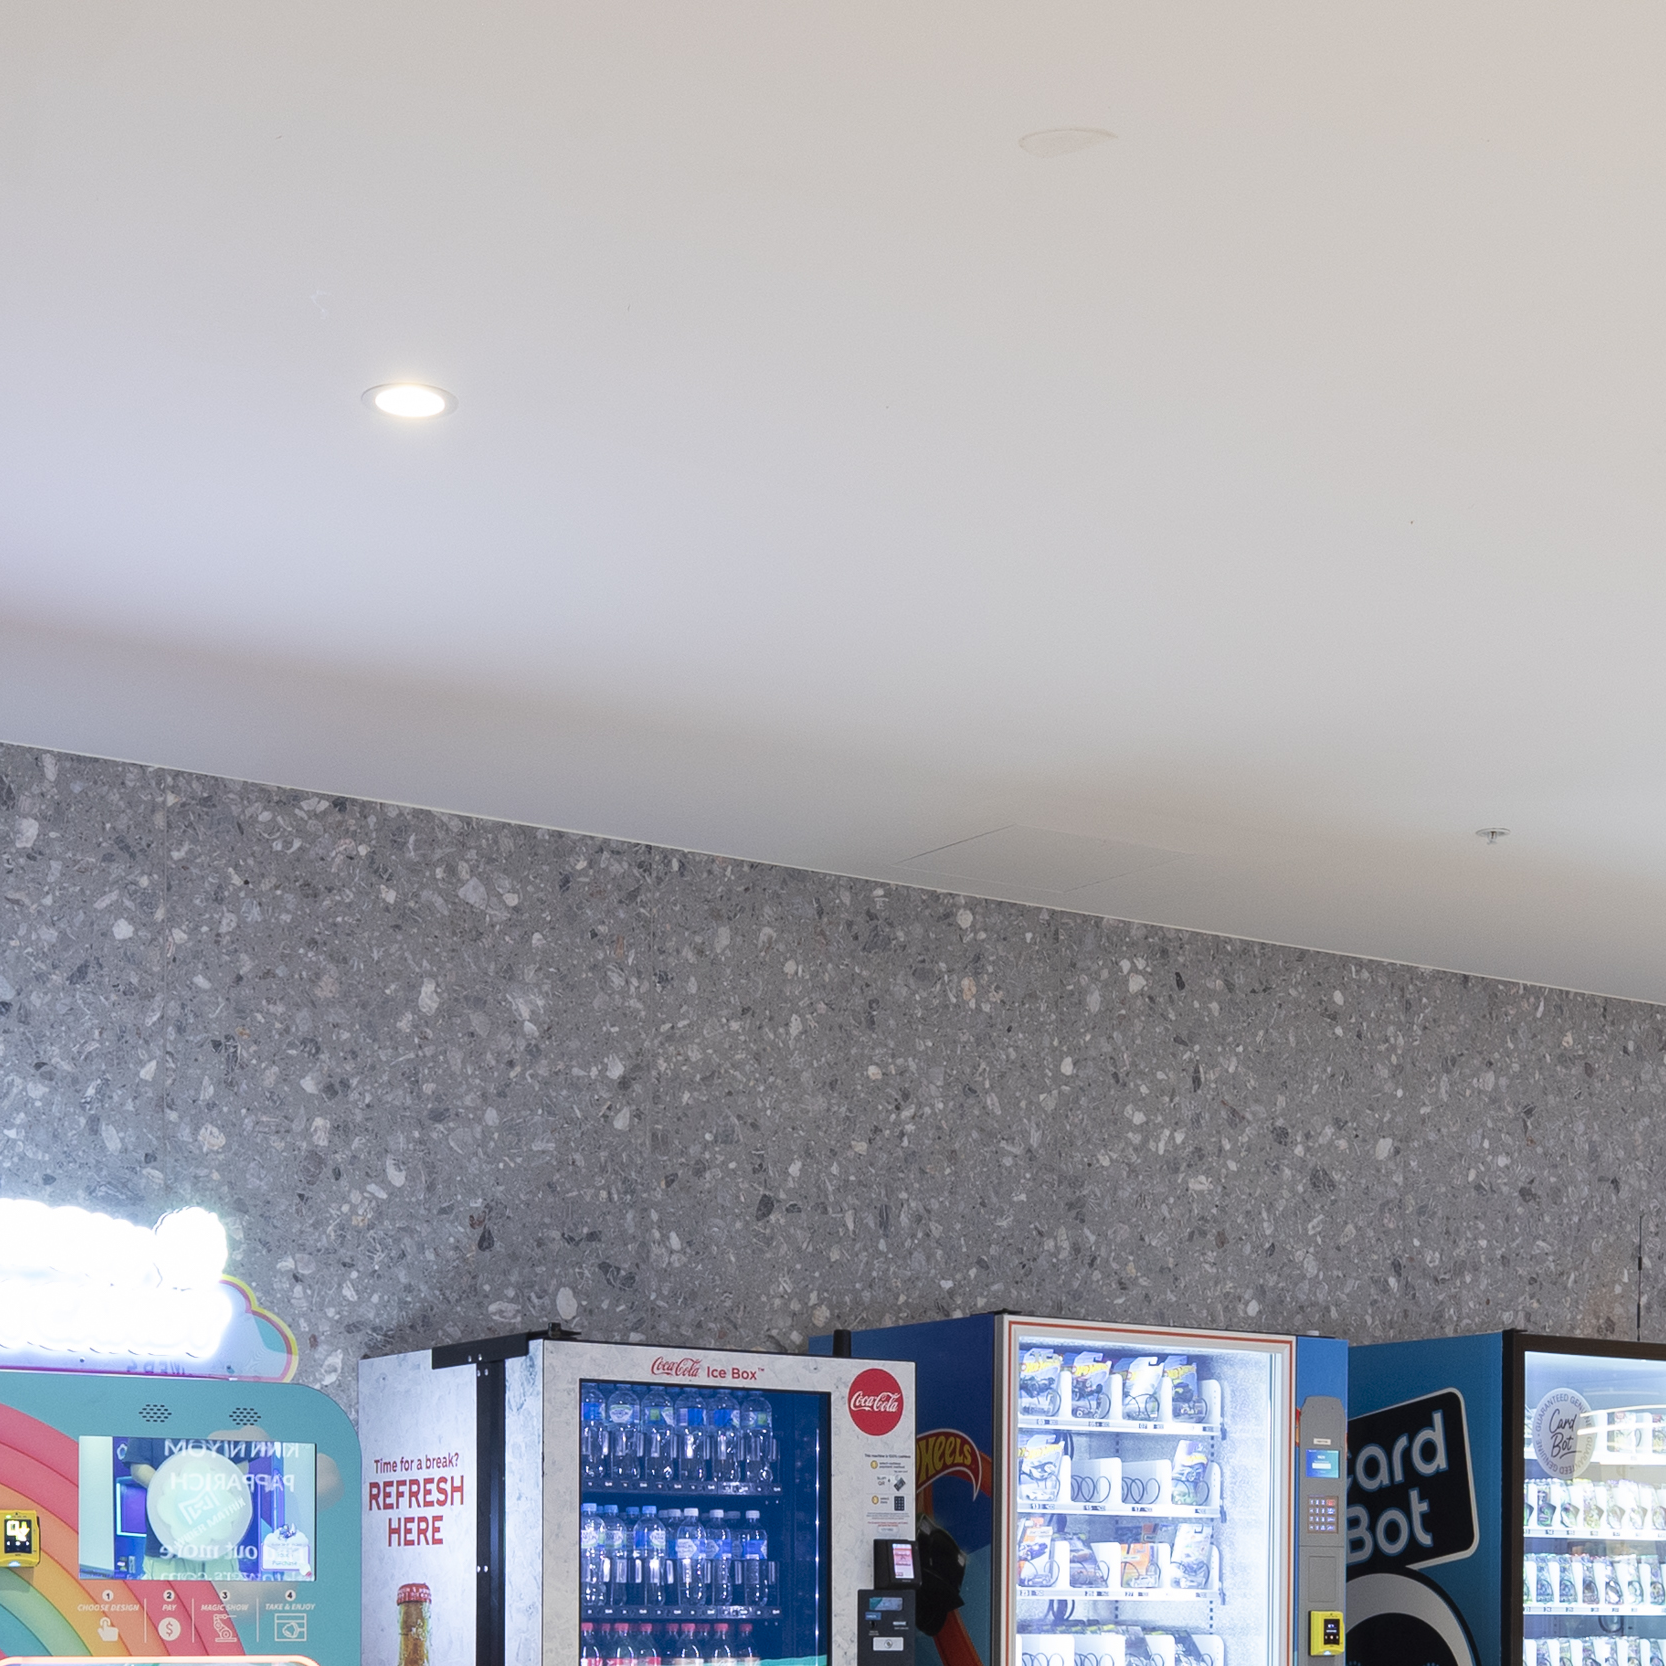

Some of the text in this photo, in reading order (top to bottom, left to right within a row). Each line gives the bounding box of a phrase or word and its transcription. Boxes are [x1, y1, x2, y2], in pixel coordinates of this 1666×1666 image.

[651, 1356, 702, 1377] Coca-Cola
[707, 1366, 727, 1379] Ice
[850, 1390, 901, 1412] Coca-Cola
[1549, 1408, 1577, 1433] Card
[1346, 1410, 1449, 1492] ard
[1551, 1432, 1576, 1458] Bot
[374, 1458, 397, 1473] Time
[399, 1456, 413, 1471] for
[424, 1452, 460, 1469] break?
[369, 1474, 465, 1511] REFRESH
[387, 1515, 444, 1548] HERE
[1347, 1486, 1434, 1567] Bot
[77, 1604, 139, 1612] CHOOSE DESIGN
[162, 1604, 177, 1612] PAY
[201, 1604, 249, 1612] MAGIC SHOW
[265, 1603, 283, 1611] TAKE
[291, 1603, 316, 1611] ENJOY
